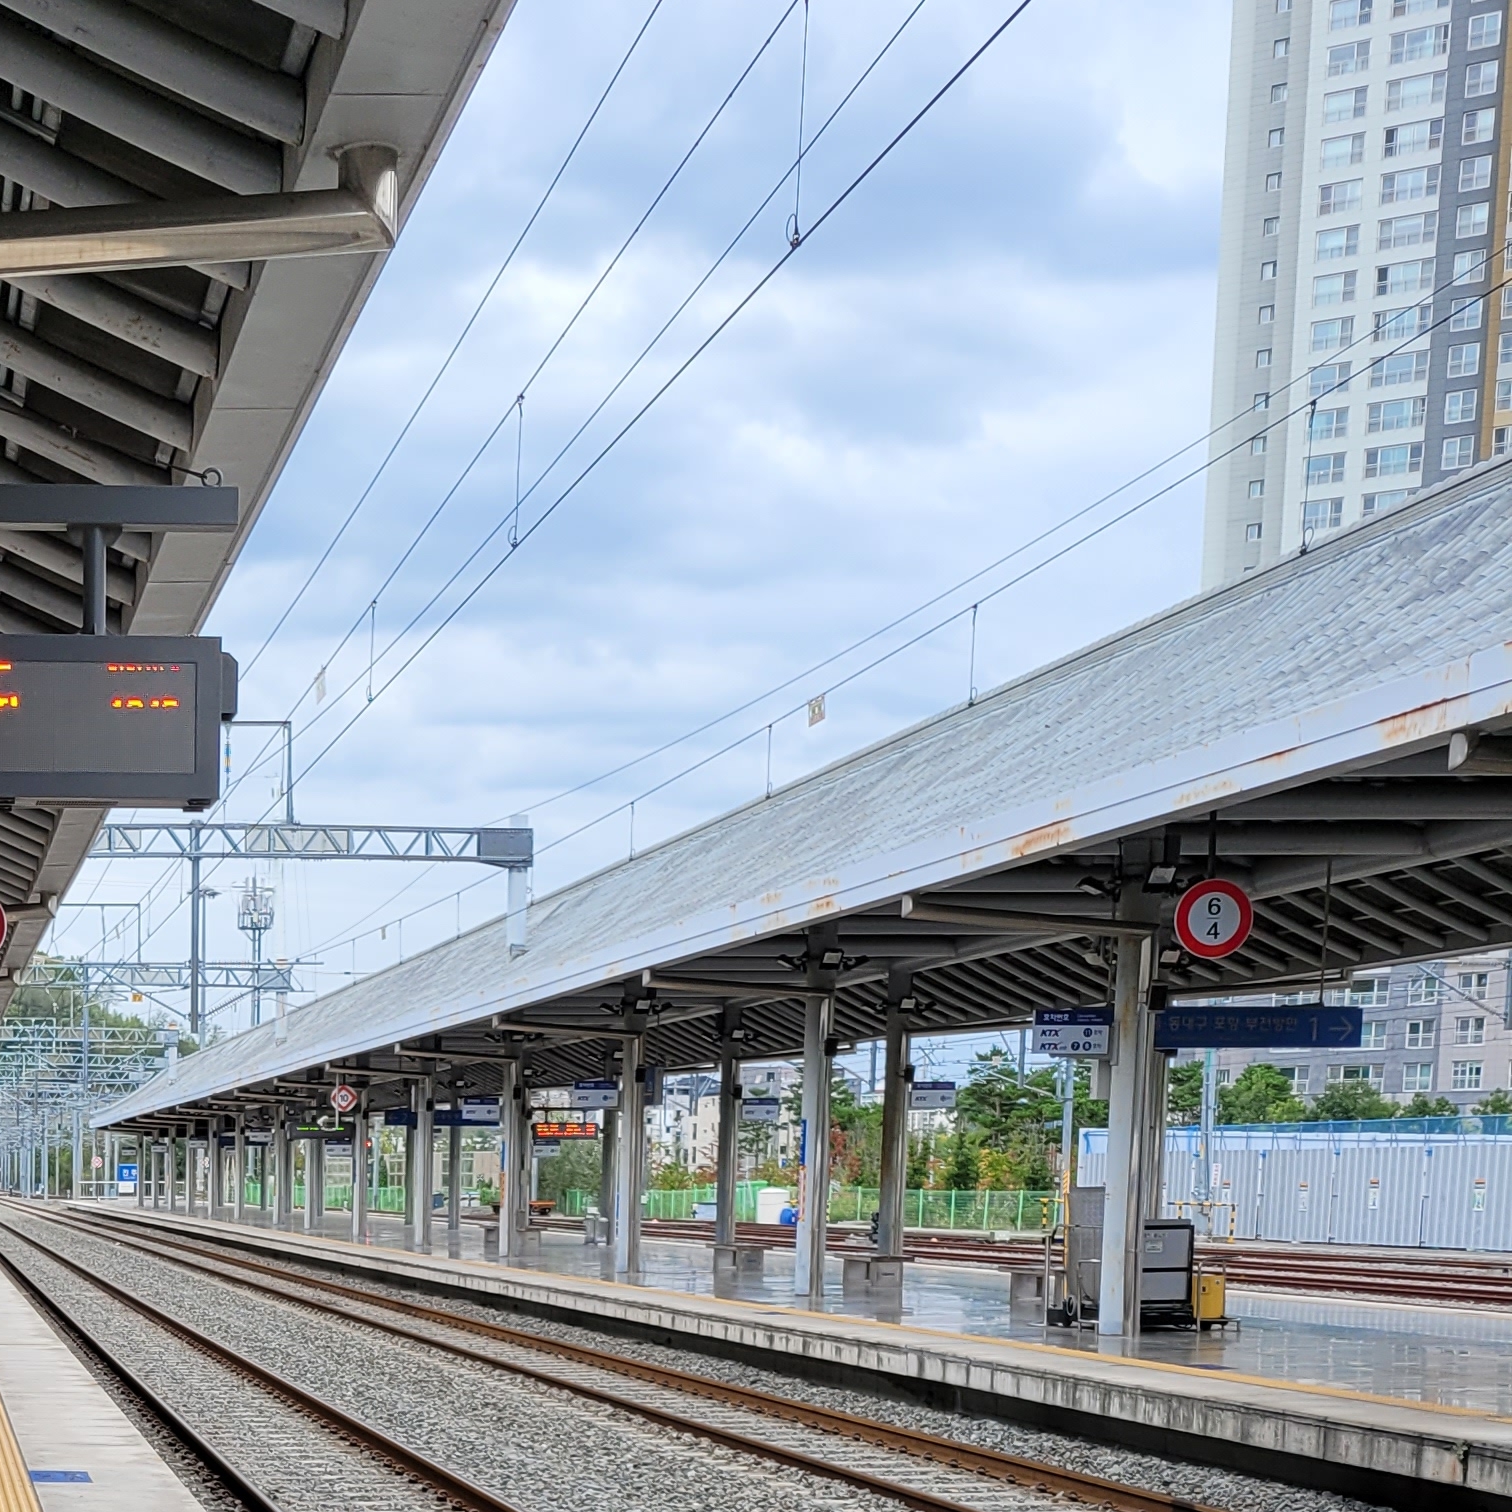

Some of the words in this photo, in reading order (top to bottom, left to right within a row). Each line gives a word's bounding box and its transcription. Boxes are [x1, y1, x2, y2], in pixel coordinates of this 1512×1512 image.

[1208, 897, 1221, 916] 6
[1206, 921, 1220, 940] 4
[1040, 1028, 1063, 1037] KTX
[1308, 1017, 1318, 1042] 1
[1039, 1041, 1063, 1050] KTX
